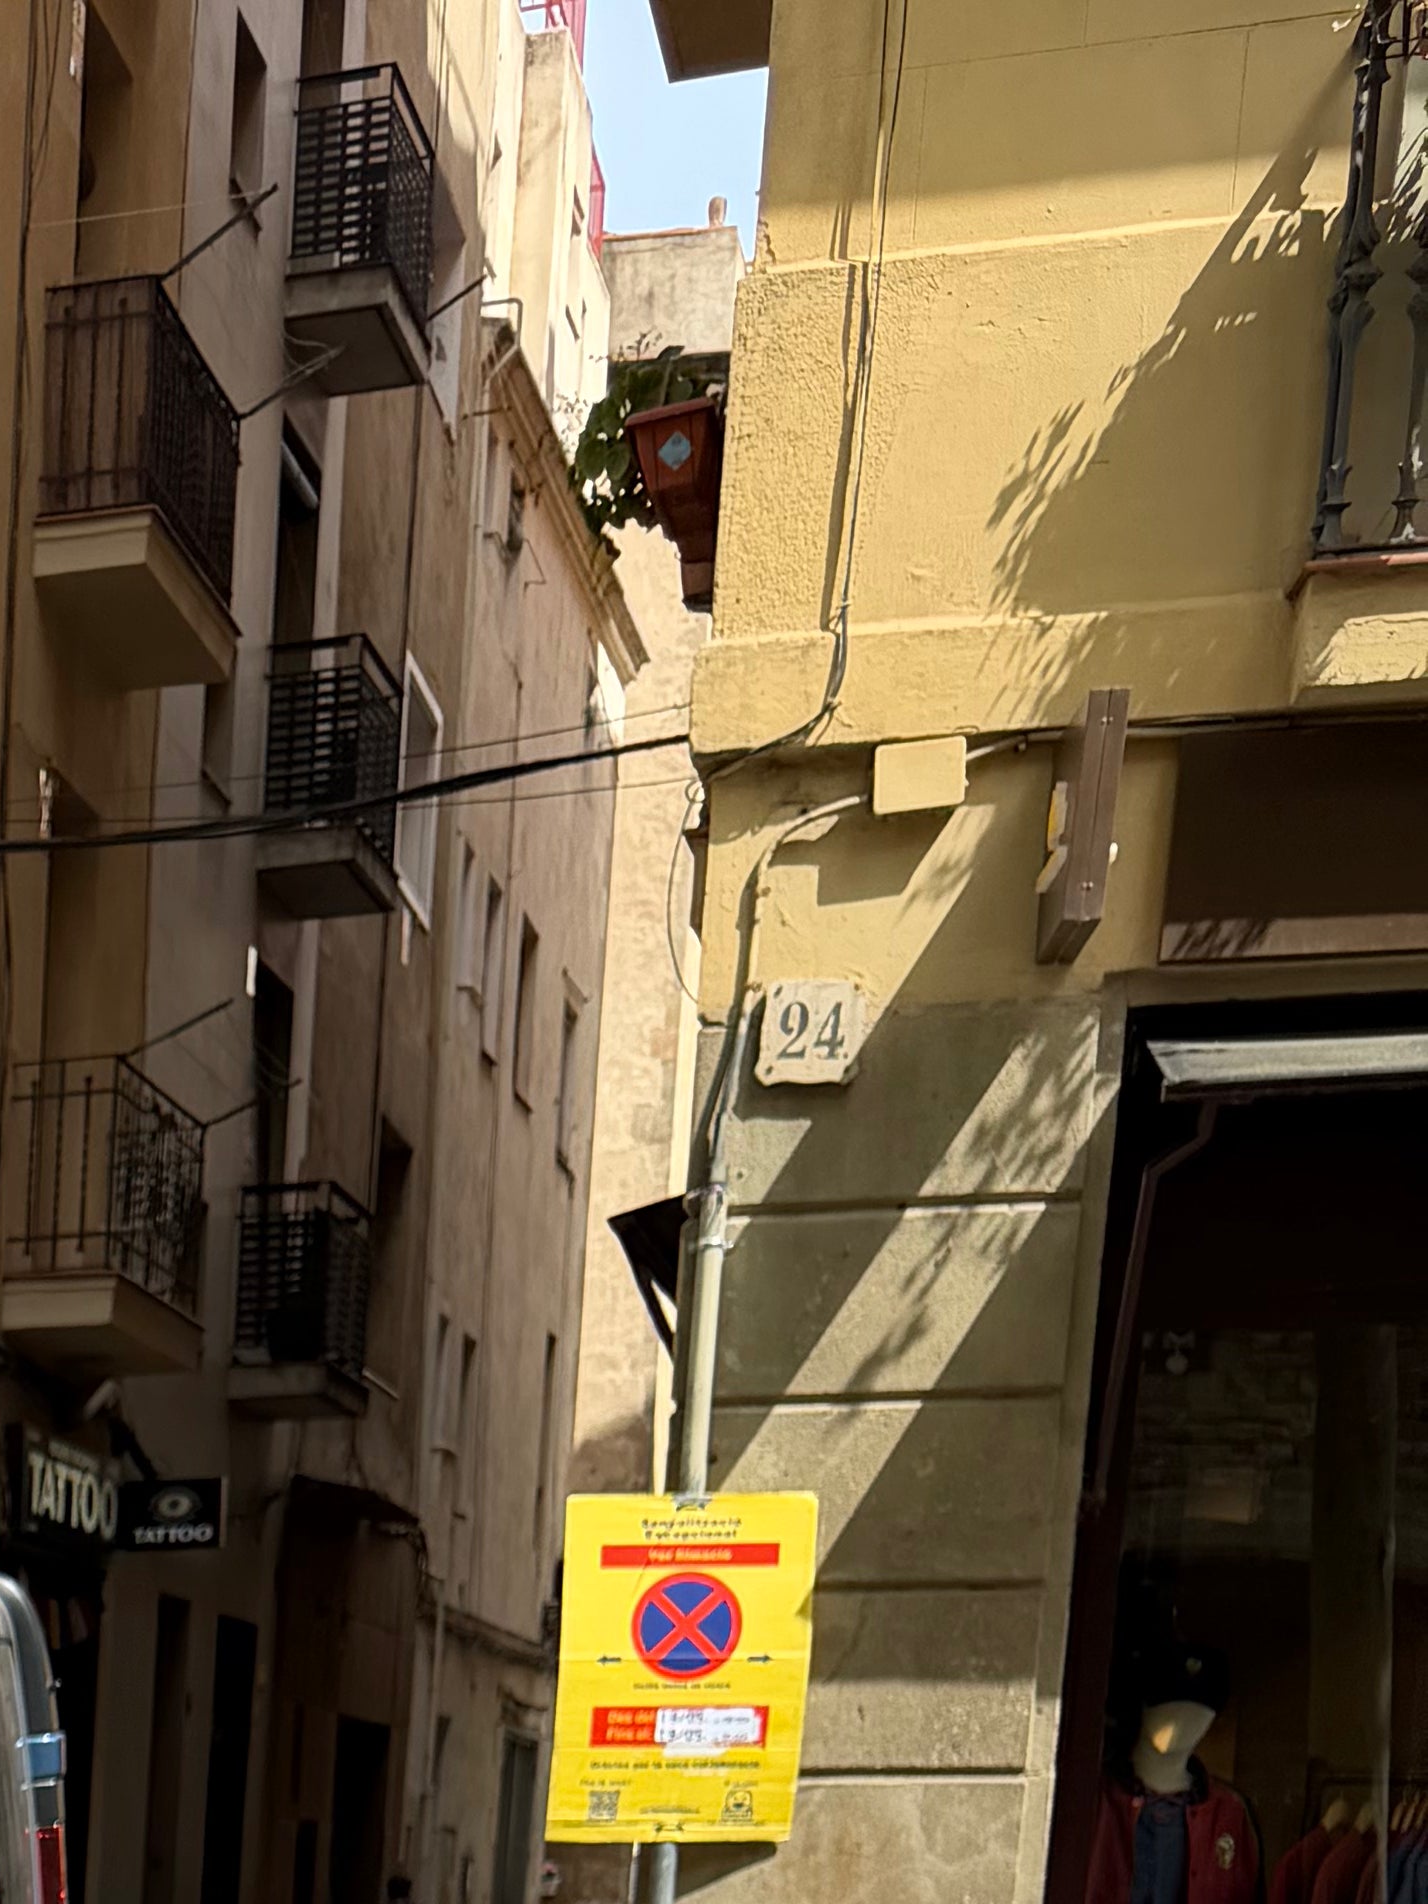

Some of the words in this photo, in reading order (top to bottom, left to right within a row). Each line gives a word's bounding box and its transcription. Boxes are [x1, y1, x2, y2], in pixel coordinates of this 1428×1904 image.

[777, 1001, 846, 1061] 24
[28, 1451, 119, 1541] TATTOO
[133, 1523, 214, 1545] TATTOO
